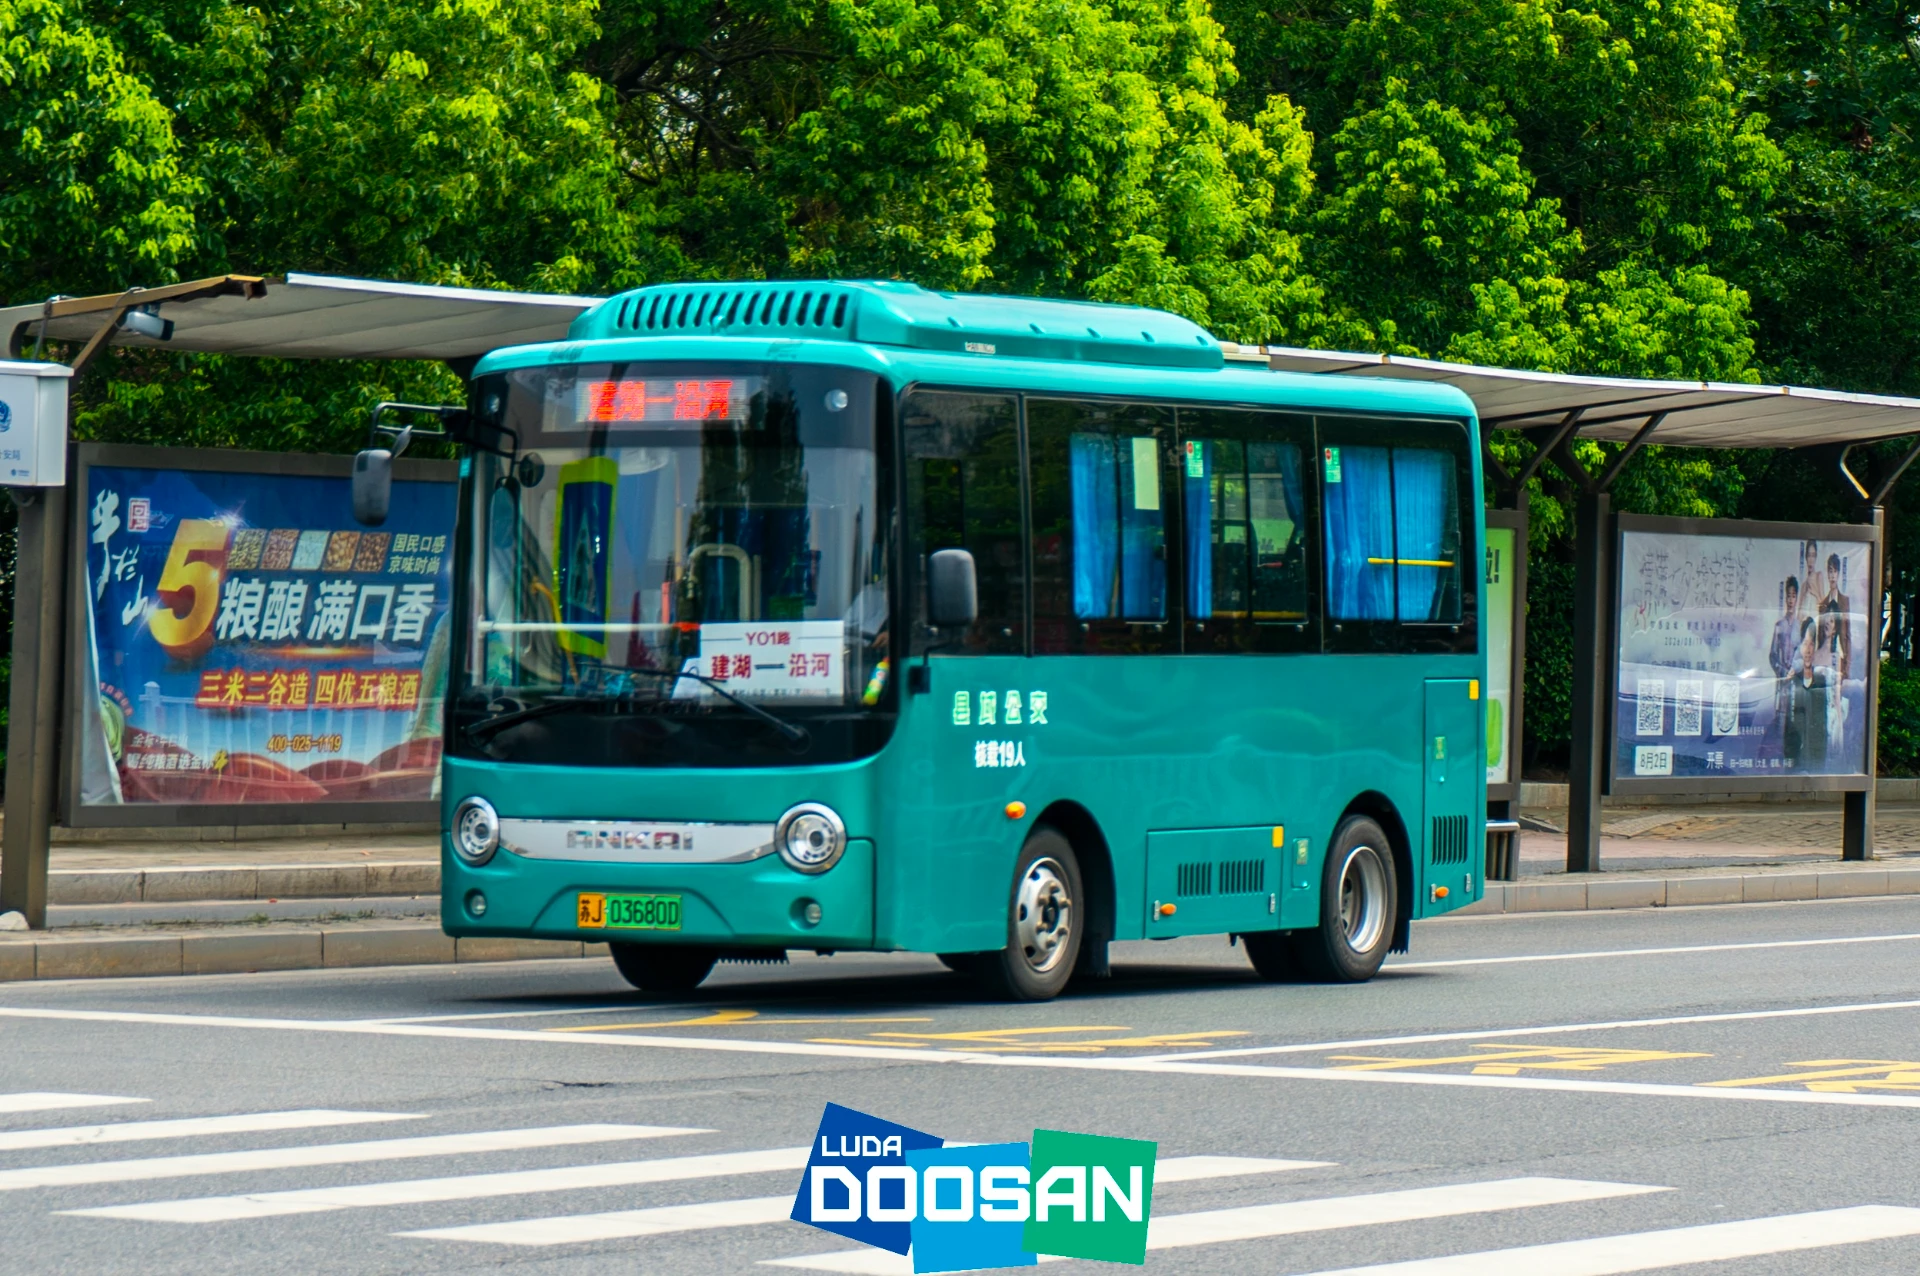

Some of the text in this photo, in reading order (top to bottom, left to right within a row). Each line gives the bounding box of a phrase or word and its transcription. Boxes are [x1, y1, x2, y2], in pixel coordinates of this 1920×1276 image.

[393, 533, 446, 554] 国民口感
[387, 555, 440, 575] 京味时尚
[215, 577, 308, 641] 粮酿
[307, 580, 435, 643] 满口香
[198, 672, 420, 707] 三米二谷造 四优五粮酒
[267, 735, 342, 752] 400-025-1119
[1640, 753, 1667, 769] 8月2日
[1706, 752, 1724, 769] 开票
[567, 830, 693, 850] ANKAI
